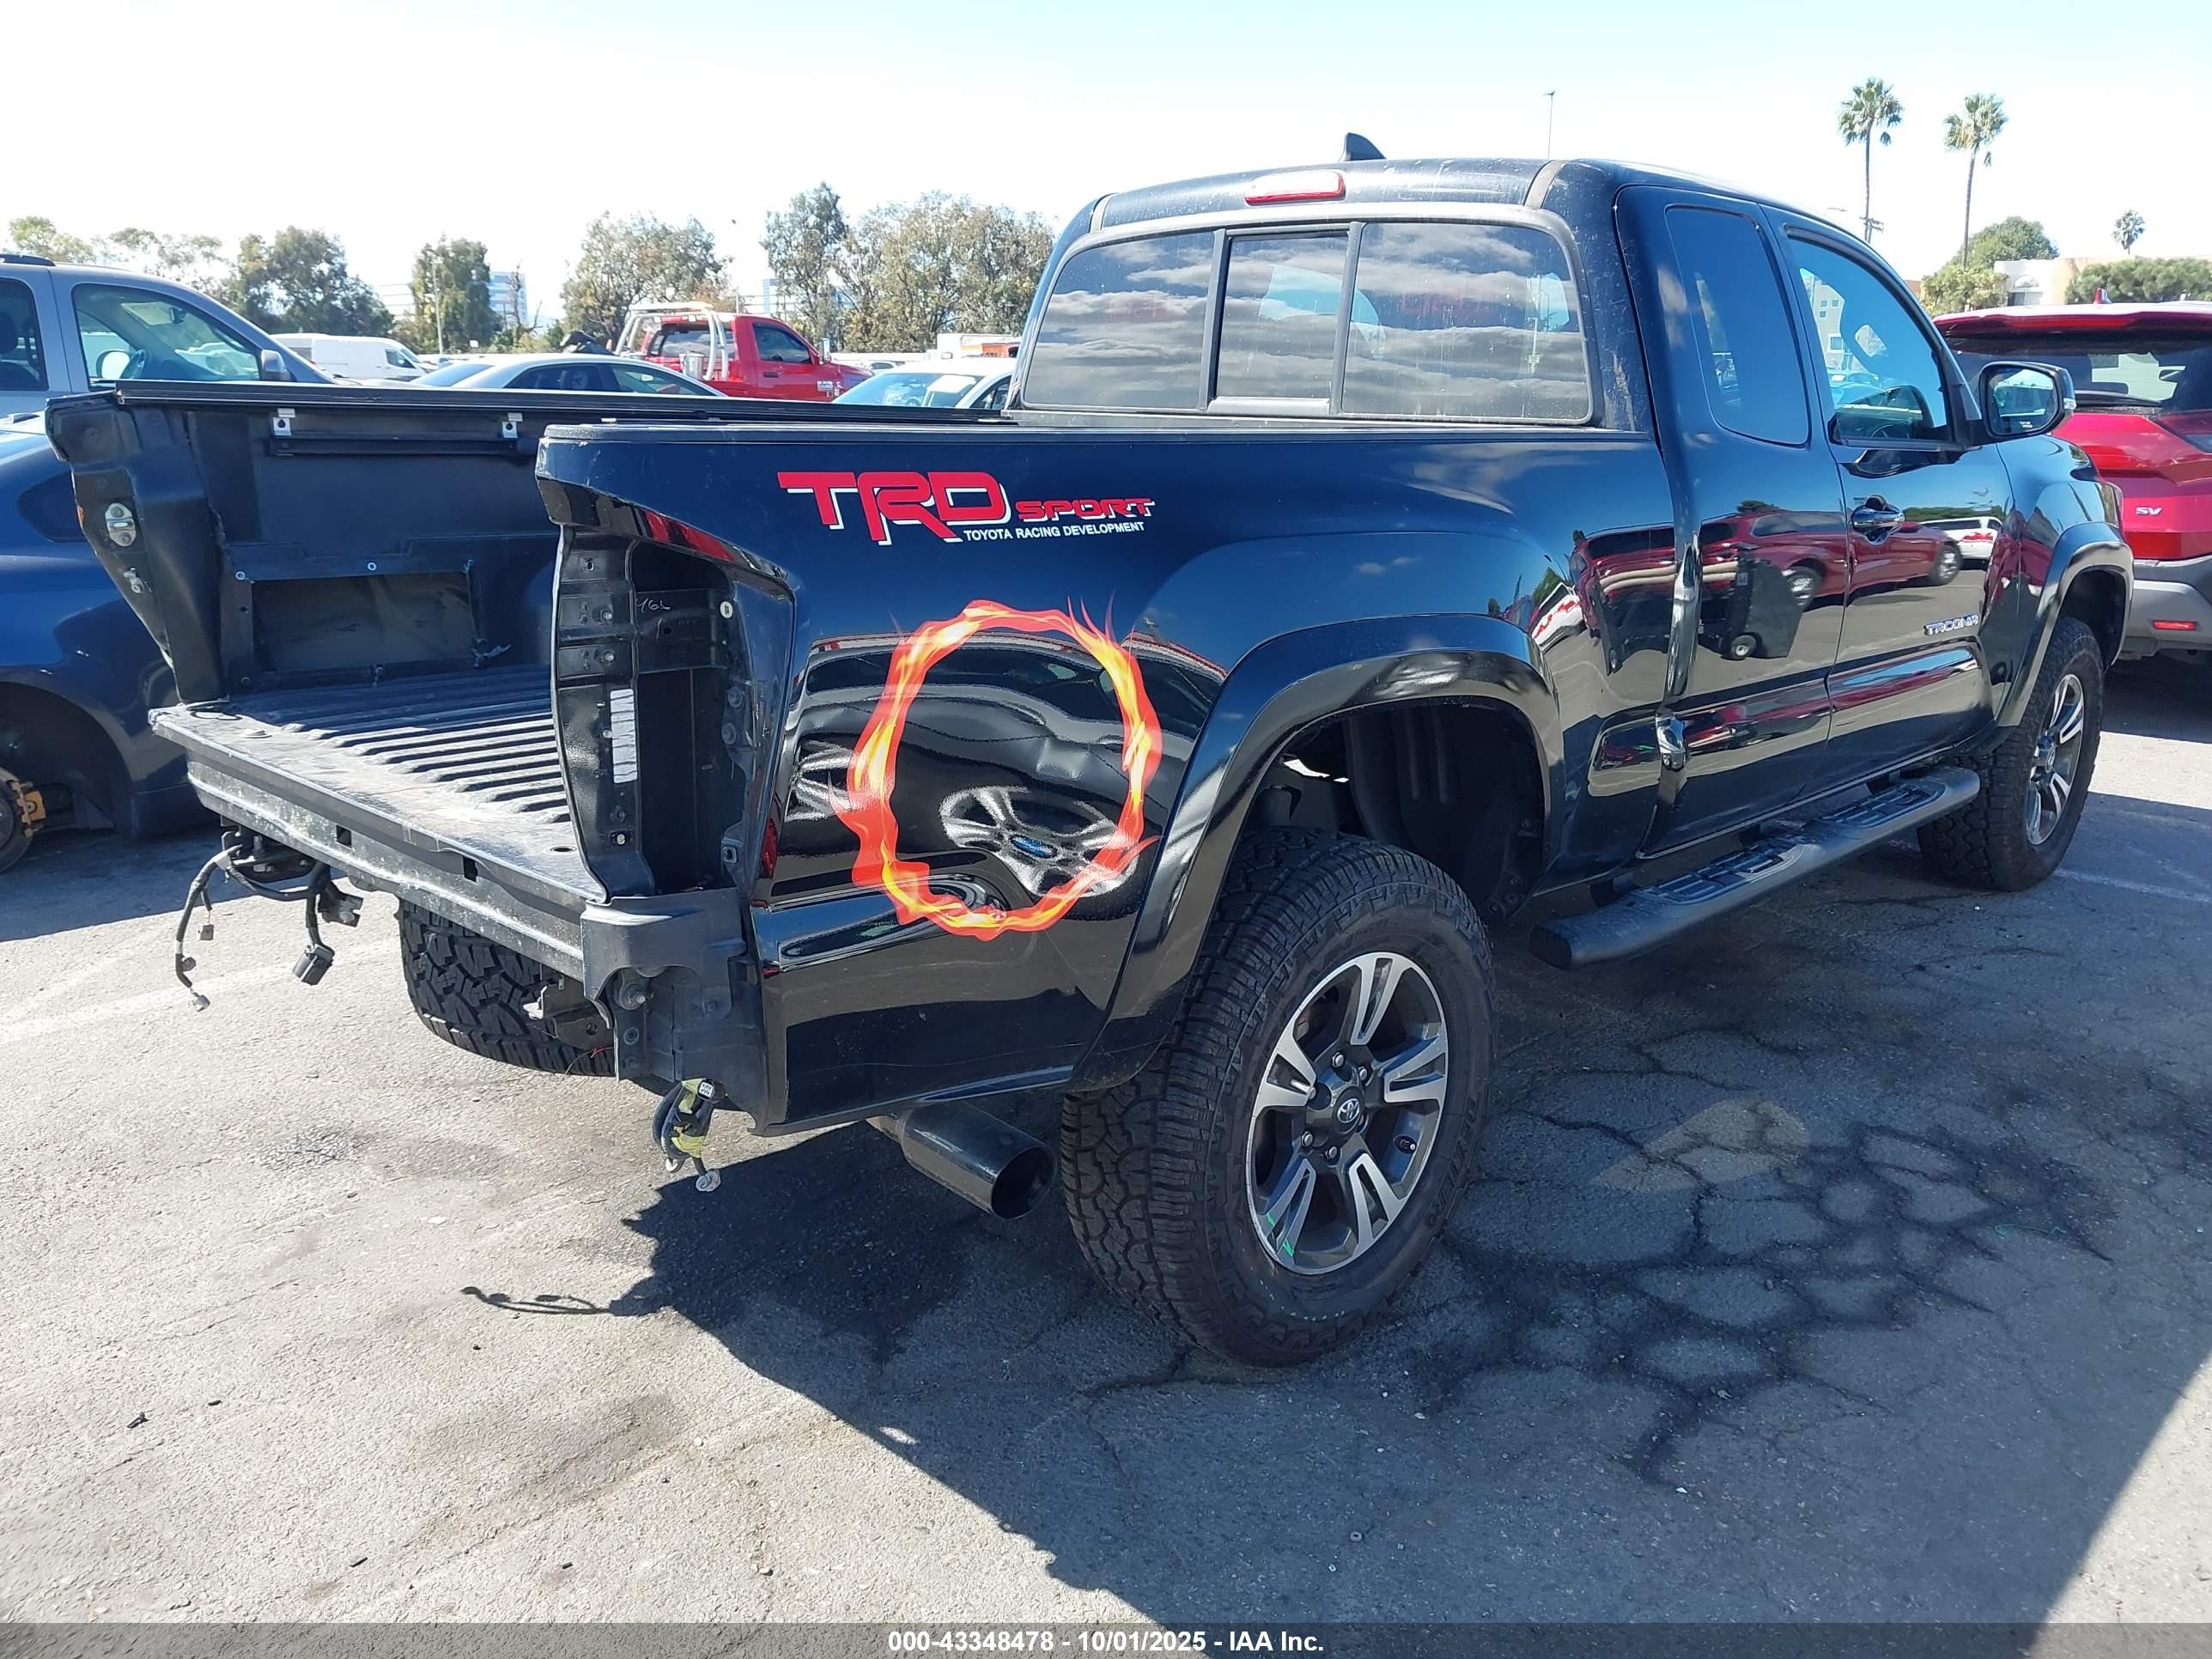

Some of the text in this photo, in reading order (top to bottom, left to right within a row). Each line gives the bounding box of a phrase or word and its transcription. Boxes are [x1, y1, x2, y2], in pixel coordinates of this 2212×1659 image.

[778, 471, 1155, 545] TRD SPORT
[2136, 507, 2162, 515] SV
[963, 521, 1145, 542] TOYOTA RACING DEVELOPMENT
